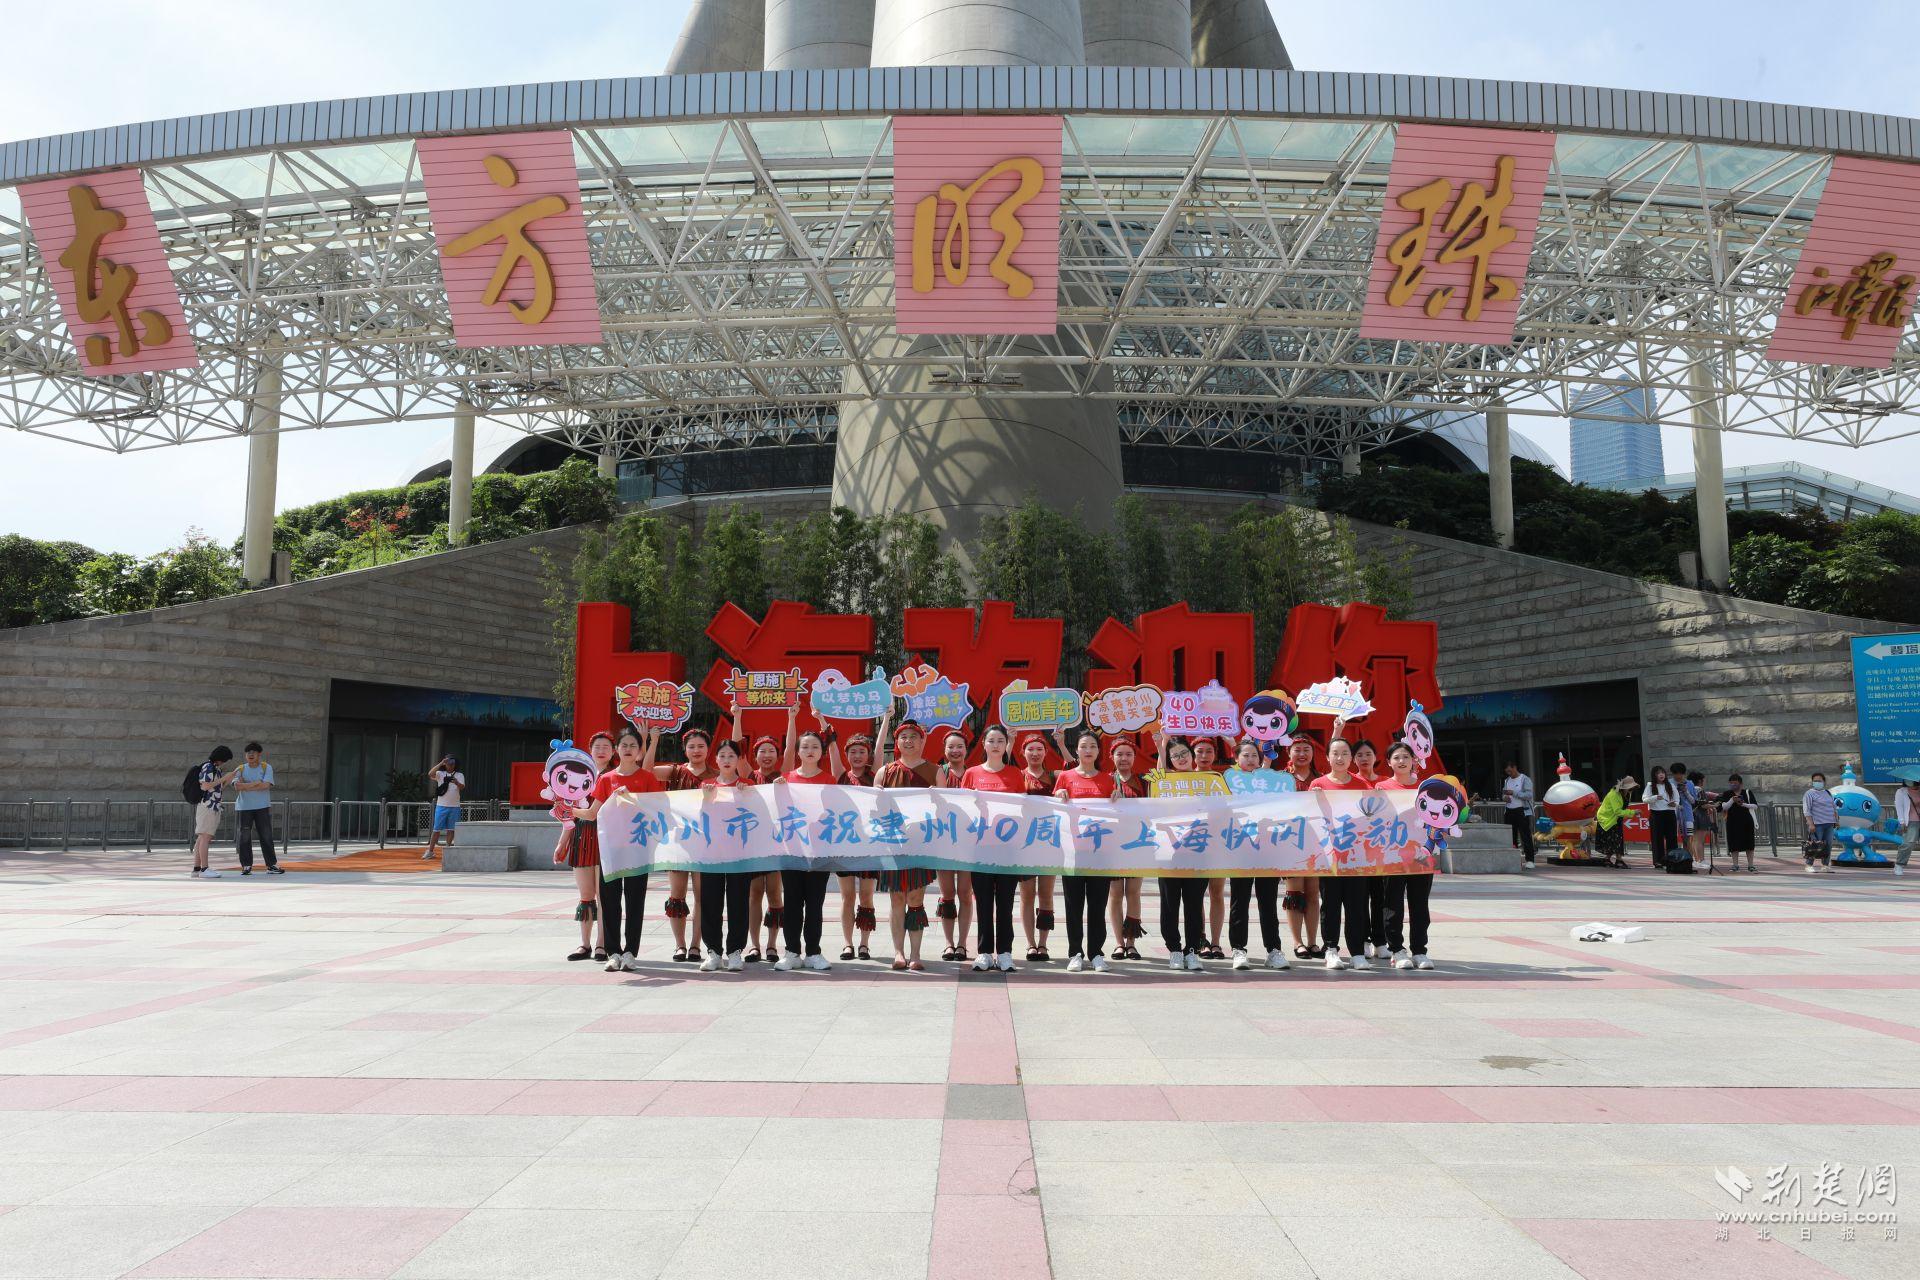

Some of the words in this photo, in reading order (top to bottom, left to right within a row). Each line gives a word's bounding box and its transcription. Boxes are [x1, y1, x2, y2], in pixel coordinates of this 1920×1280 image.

[752, 672, 780, 688] 恩施
[637, 685, 671, 706] 恩施
[746, 690, 786, 705] 等你来
[1097, 693, 1152, 712] 凉爽利川
[1300, 692, 1357, 710] 大美恩施
[631, 705, 674, 721] 欢迎您
[1006, 698, 1075, 721] 恩施青年
[1170, 697, 1195, 712] 40
[1099, 706, 1154, 725] 度假天堂
[1166, 714, 1233, 730] 生日快乐
[1158, 779, 1222, 791] 有趣的人
[629, 806, 1409, 853] 利川市庆祝建州40周年上海快闪活动
